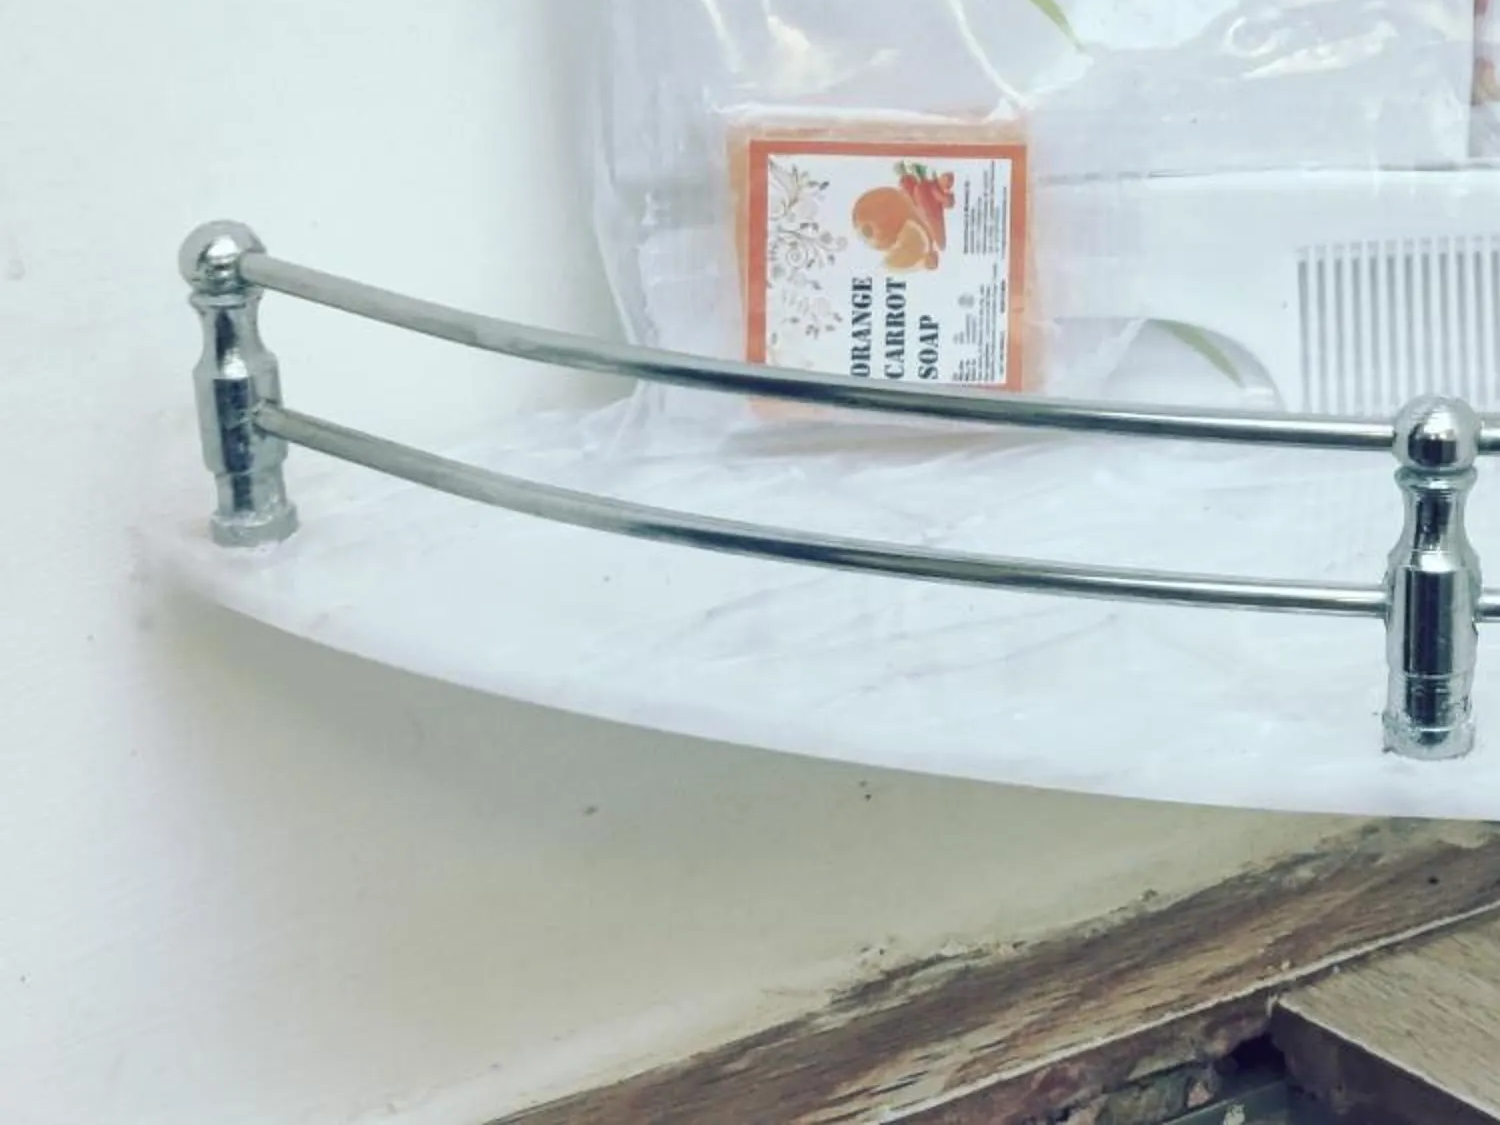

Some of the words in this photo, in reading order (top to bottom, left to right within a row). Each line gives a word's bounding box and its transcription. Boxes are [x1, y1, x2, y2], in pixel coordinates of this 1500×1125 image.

[850, 276, 873, 378] ORANGE
[883, 277, 907, 379] CARROT
[917, 314, 939, 380] SOAP
